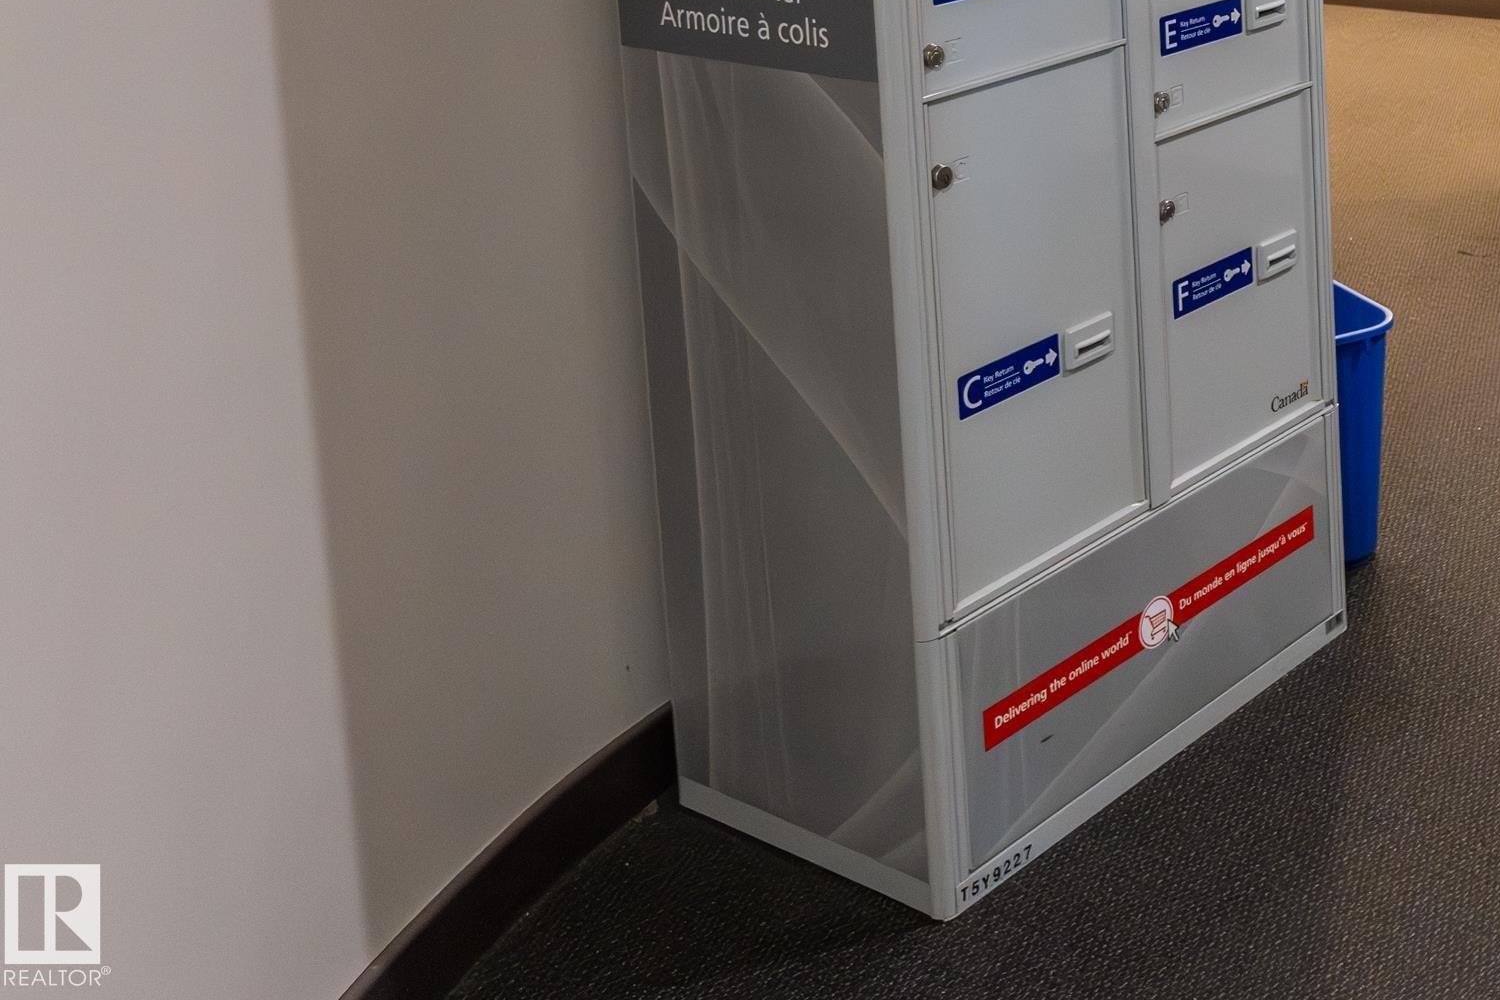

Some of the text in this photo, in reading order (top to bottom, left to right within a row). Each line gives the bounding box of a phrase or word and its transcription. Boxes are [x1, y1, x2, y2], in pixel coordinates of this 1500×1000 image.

[660, 1, 829, 48] Armoire à colis
[1164, 18, 1178, 50] E
[1180, 32, 1197, 41] Retour
[1189, 16, 1206, 25] Return
[1177, 280, 1189, 312] F
[983, 365, 1015, 384] Key Return
[984, 386, 1004, 399] Retour
[1004, 381, 1013, 390] de
[962, 374, 983, 410] C
[1270, 380, 1309, 413] Canada
[1179, 596, 1193, 611] Du
[1193, 575, 1224, 602] monde
[1224, 569, 1236, 582] en
[1236, 553, 1258, 575] ligne
[1287, 523, 1307, 542] vous
[994, 632, 1131, 730] Delivering the online world
